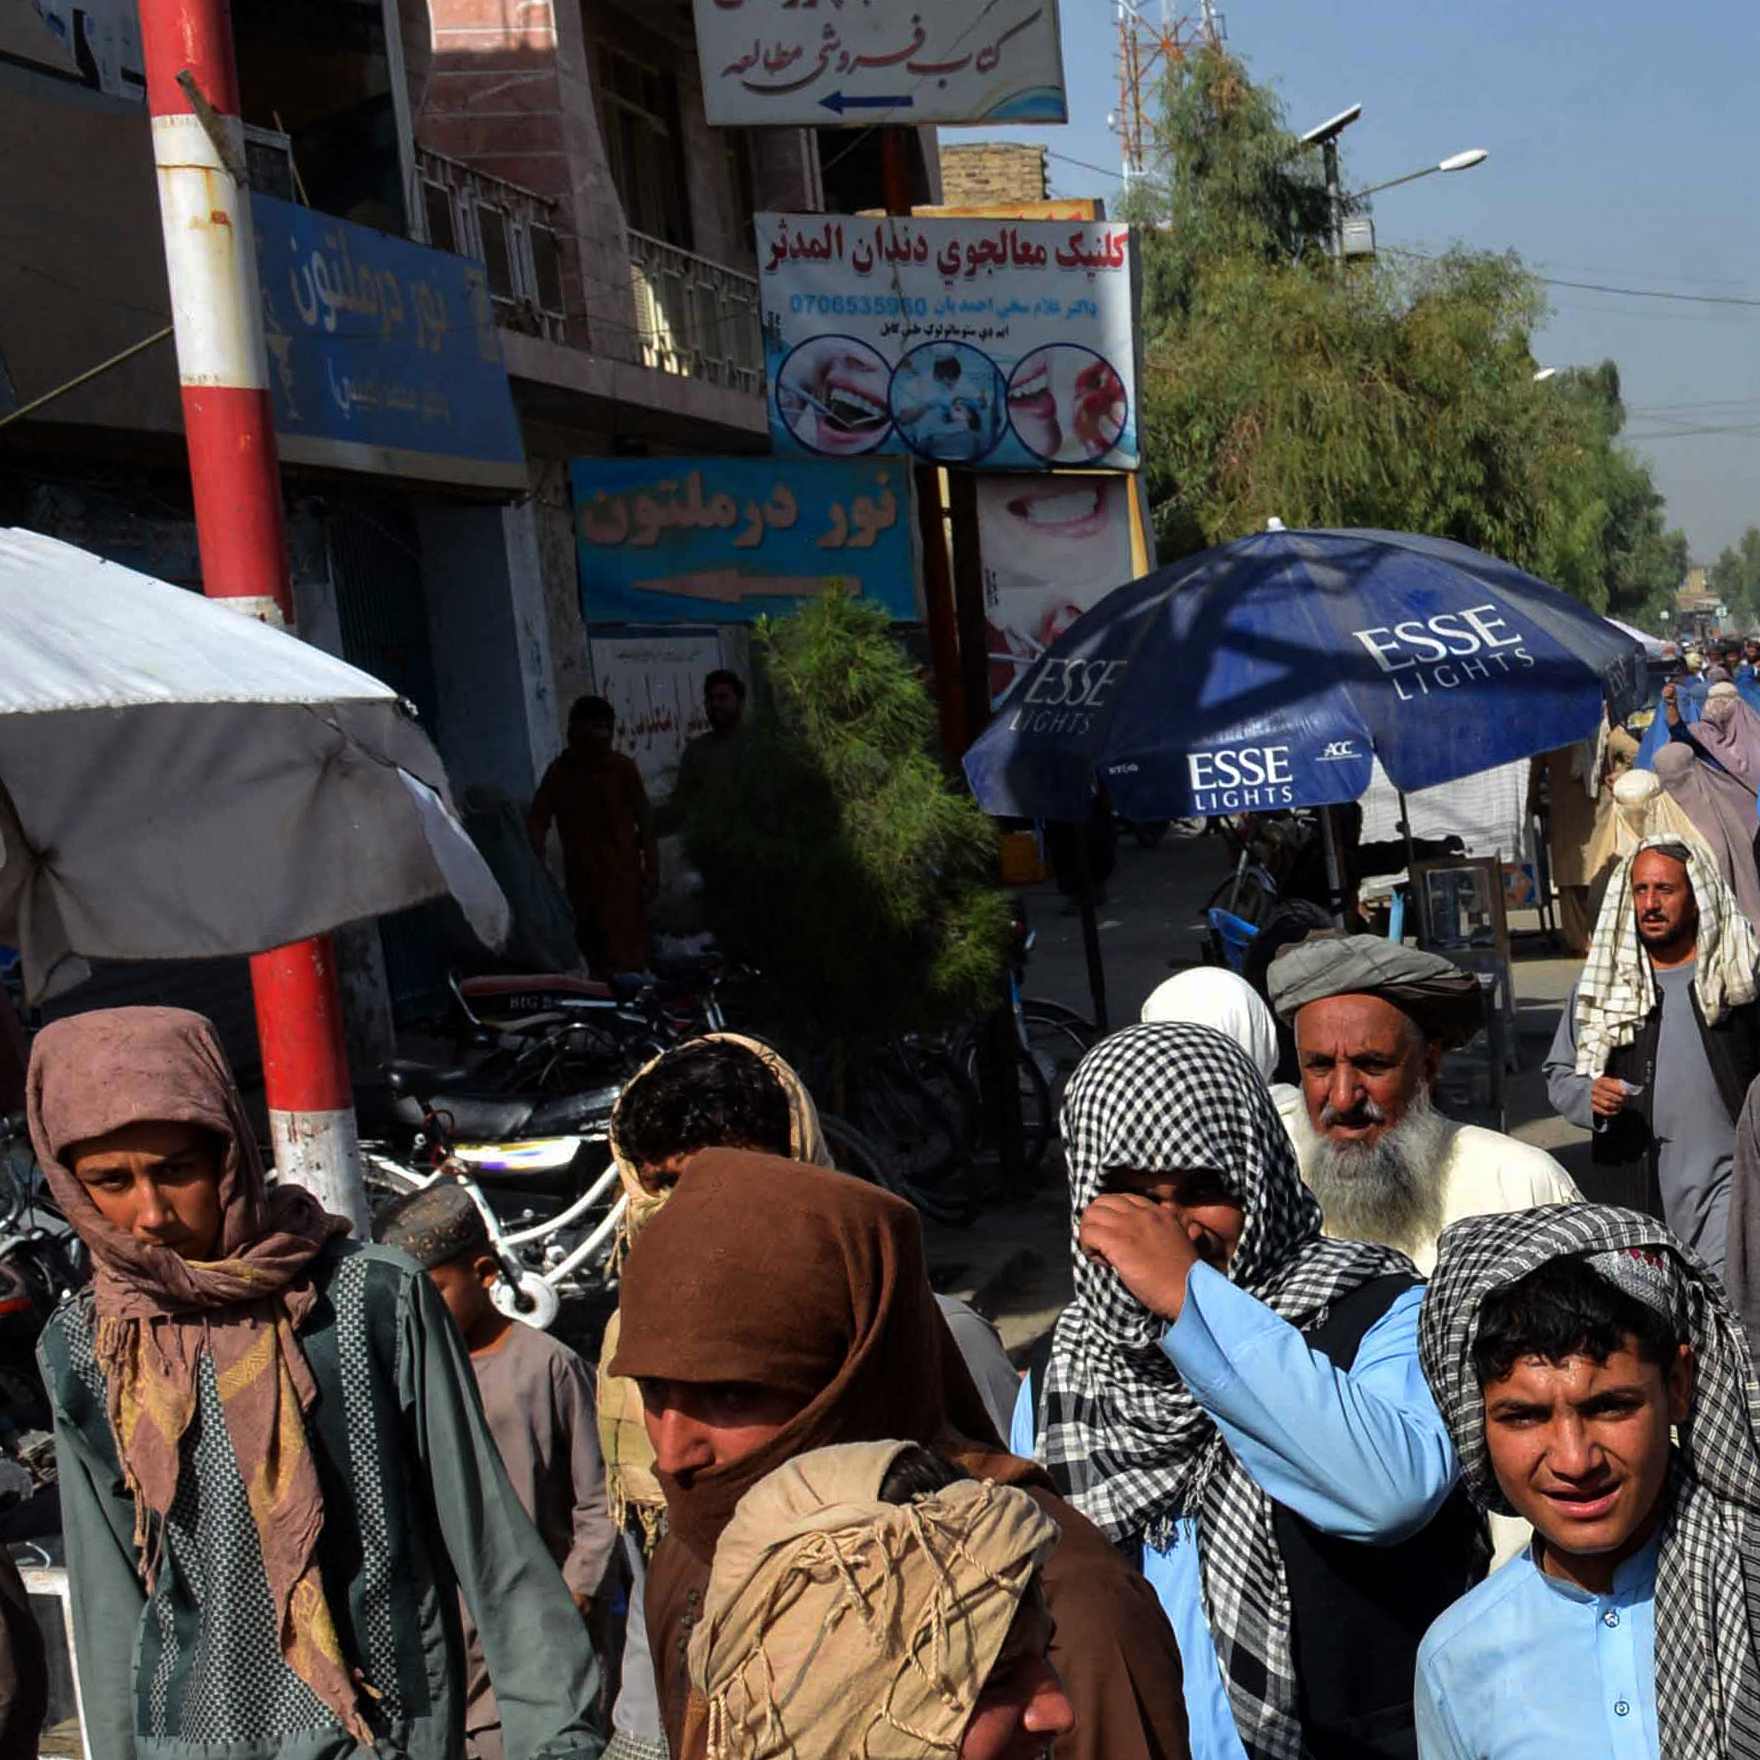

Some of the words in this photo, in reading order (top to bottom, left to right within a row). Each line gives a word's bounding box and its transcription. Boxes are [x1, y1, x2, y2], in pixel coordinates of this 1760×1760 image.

[852, 225, 928, 274] دندان
[578, 470, 797, 546] درملتون
[817, 470, 898, 547] نور
[1352, 604, 1524, 673] ESSE
[1023, 657, 1128, 707] ESSE
[1392, 647, 1536, 702] LIGHTS
[1186, 746, 1293, 791] ESSE
[1322, 740, 1354, 757] ACC
[1194, 785, 1294, 811] LIGHTS
